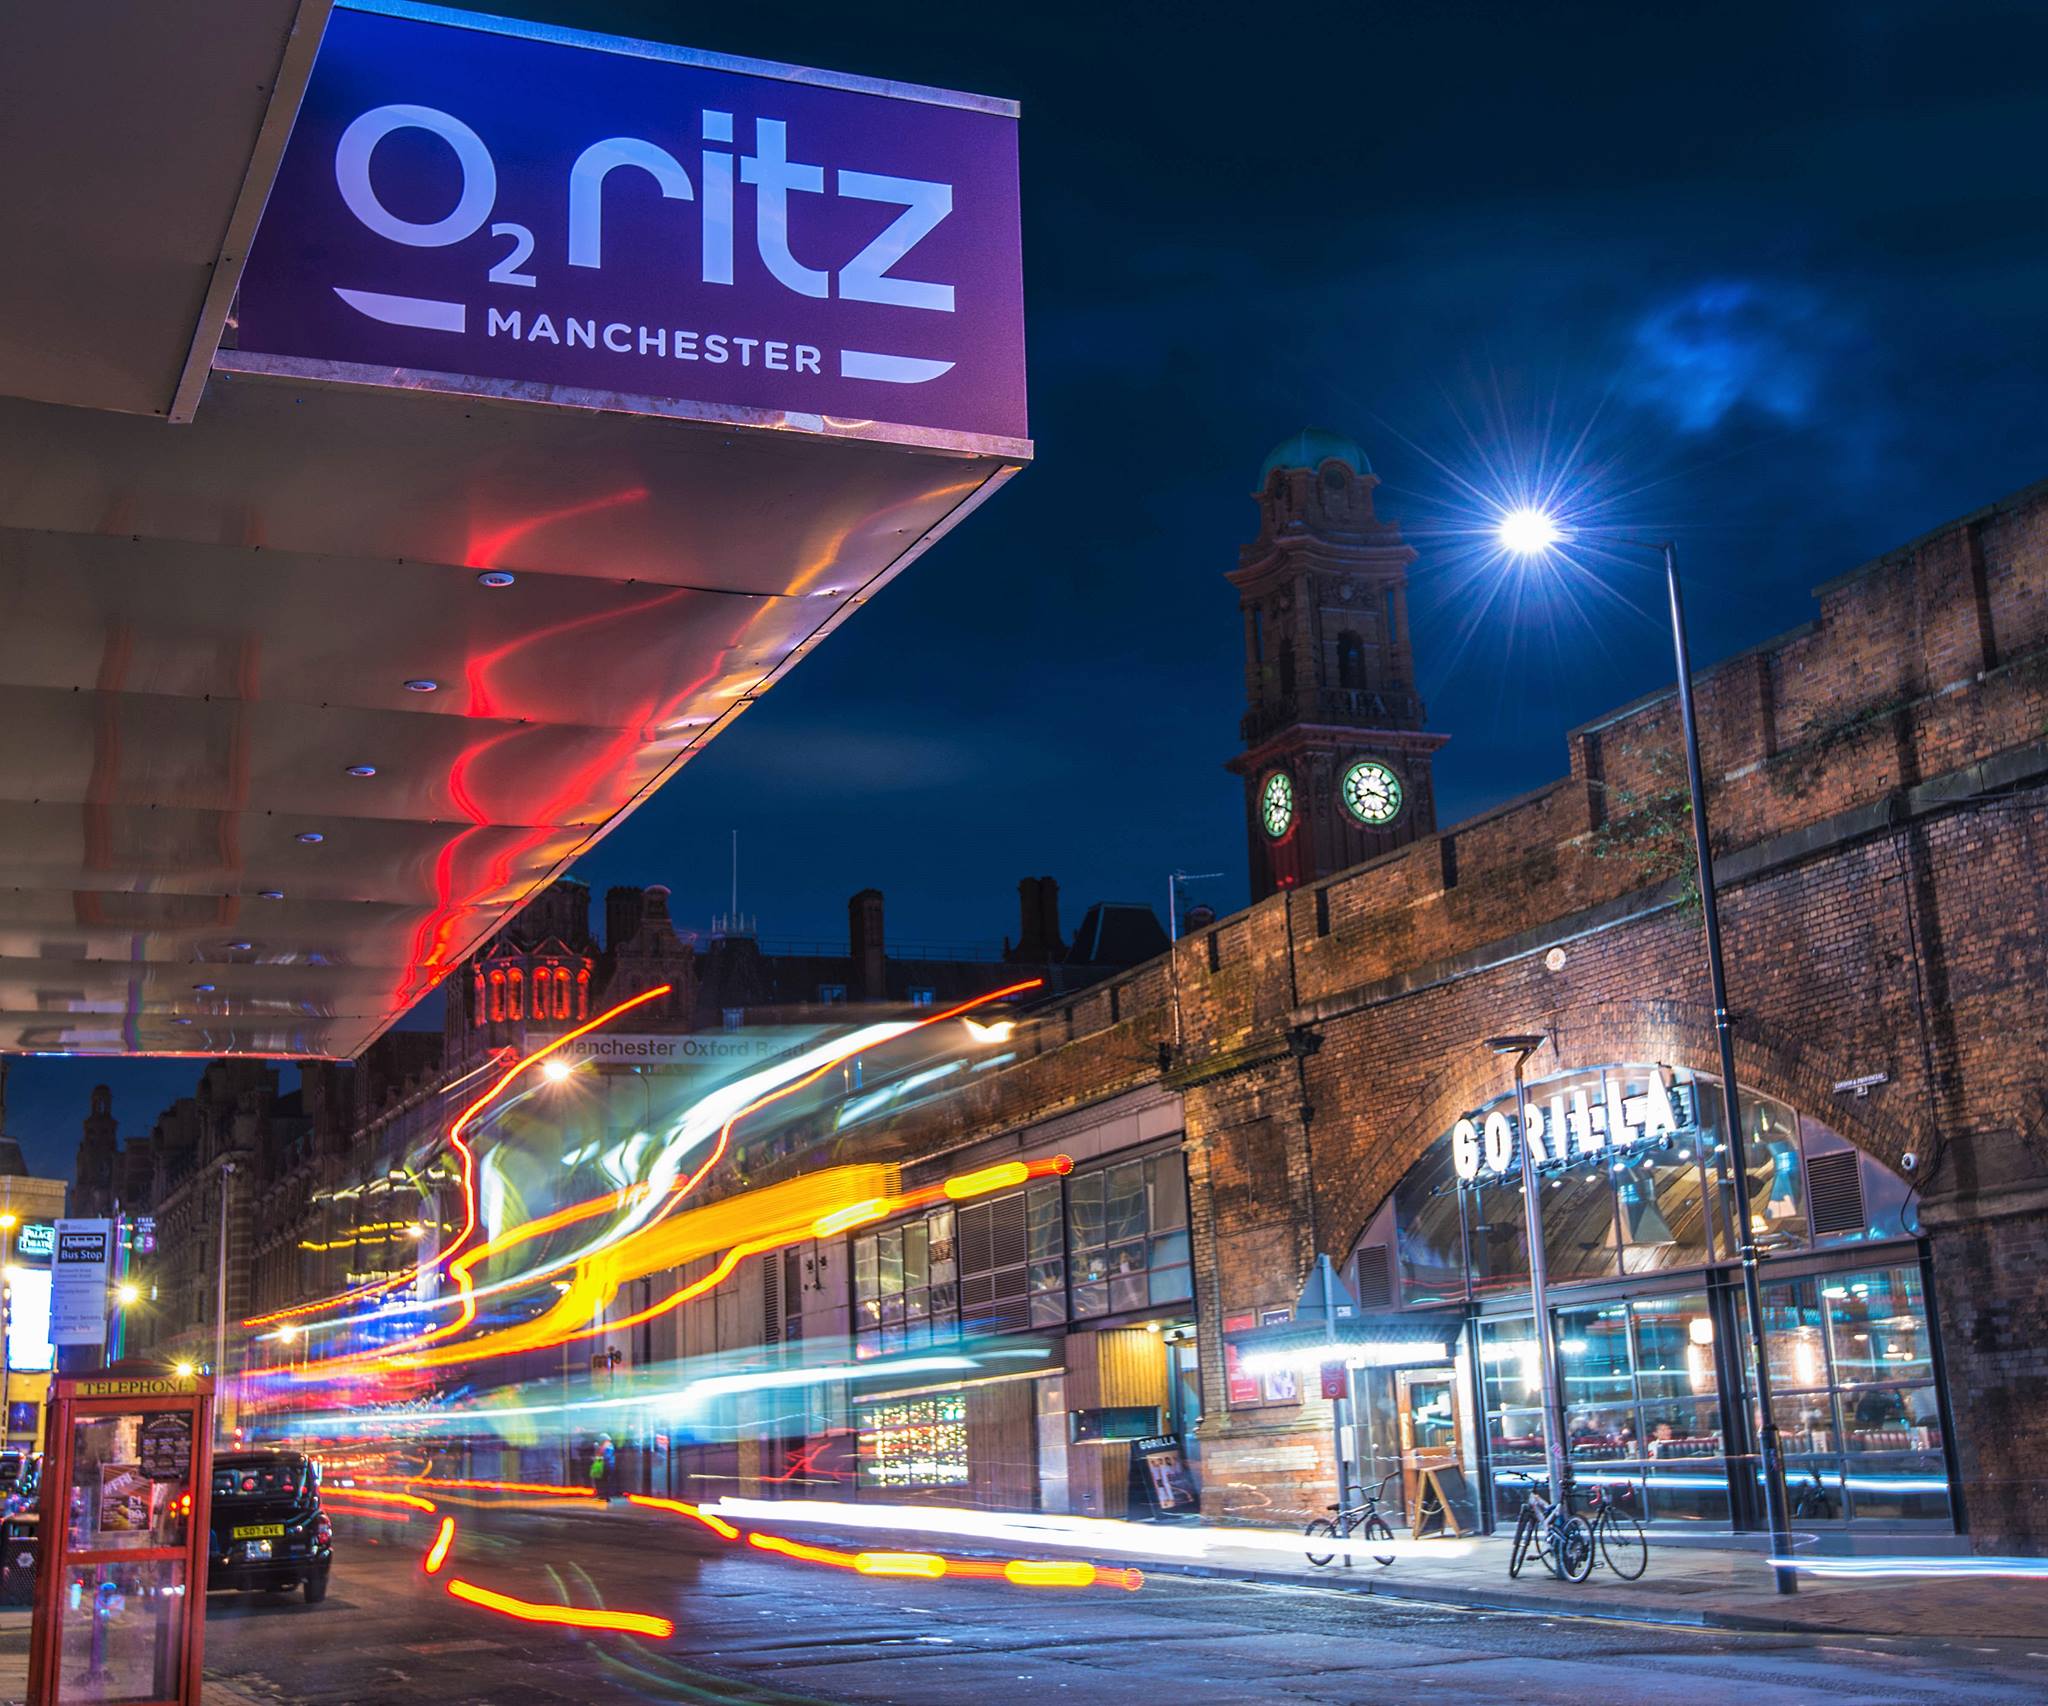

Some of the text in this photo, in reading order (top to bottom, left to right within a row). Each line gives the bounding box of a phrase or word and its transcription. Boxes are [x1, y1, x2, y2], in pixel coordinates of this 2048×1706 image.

[568, 109, 956, 313] ritz
[486, 306, 823, 376] MANCHESTER
[683, 1038, 750, 1058] Oxford
[1452, 1069, 1678, 1180] GORILLA
[145, 1236, 153, 1248] 3
[61, 1249, 79, 1259] Bus
[80, 1249, 103, 1261] Stop
[1138, 1435, 1177, 1450] GORILLA
